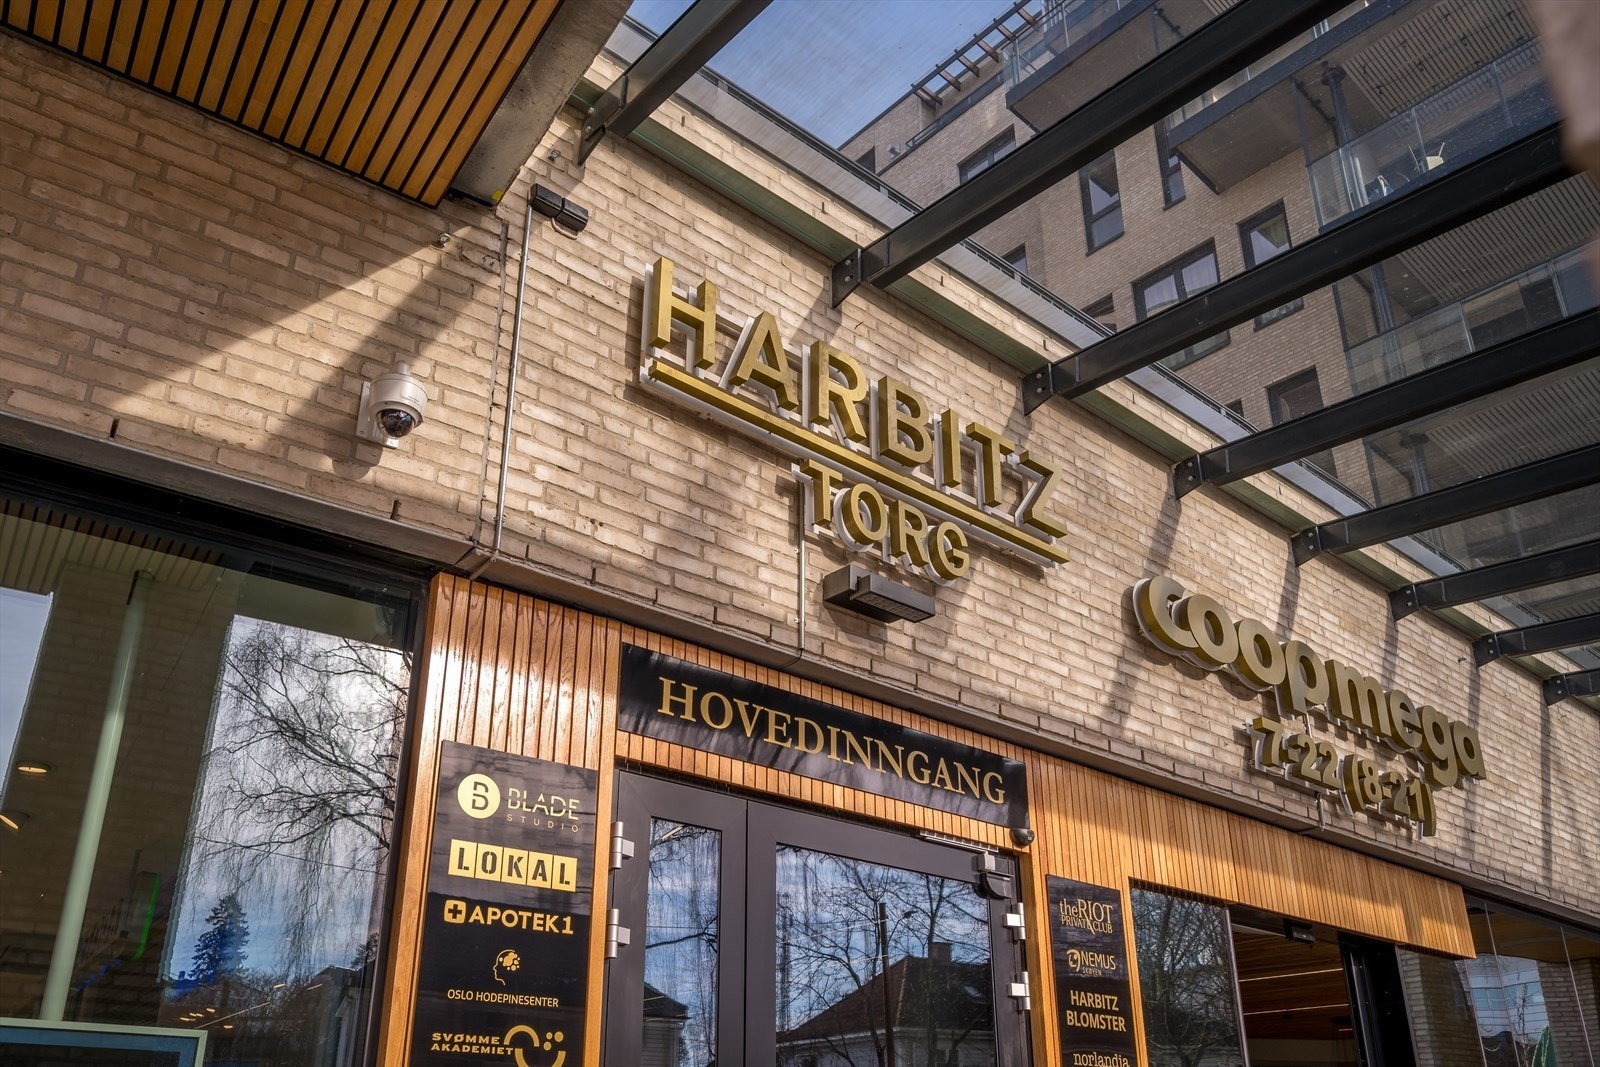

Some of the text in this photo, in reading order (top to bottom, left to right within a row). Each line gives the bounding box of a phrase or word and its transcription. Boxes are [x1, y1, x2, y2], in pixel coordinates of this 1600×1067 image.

[648, 256, 1069, 539] HARBITZ
[799, 458, 970, 581] TORG
[657, 676, 1006, 804] HOVEDINNGANG
[507, 787, 580, 821] BLADE
[506, 813, 579, 833] STUDIO
[457, 846, 571, 886] LOKAL
[1093, 920, 1113, 934] CLUB
[1081, 951, 1117, 970] NEMUS
[447, 989, 559, 1008] OSLO HODEPINESENTER
[1070, 990, 1120, 1012] HARBITZ
[1066, 1010, 1127, 1032] BLOMSTER
[430, 1043, 514, 1055] AKADEMIET
[431, 1032, 500, 1045] SVØMME
[1073, 1052, 1130, 1067] norlandia
